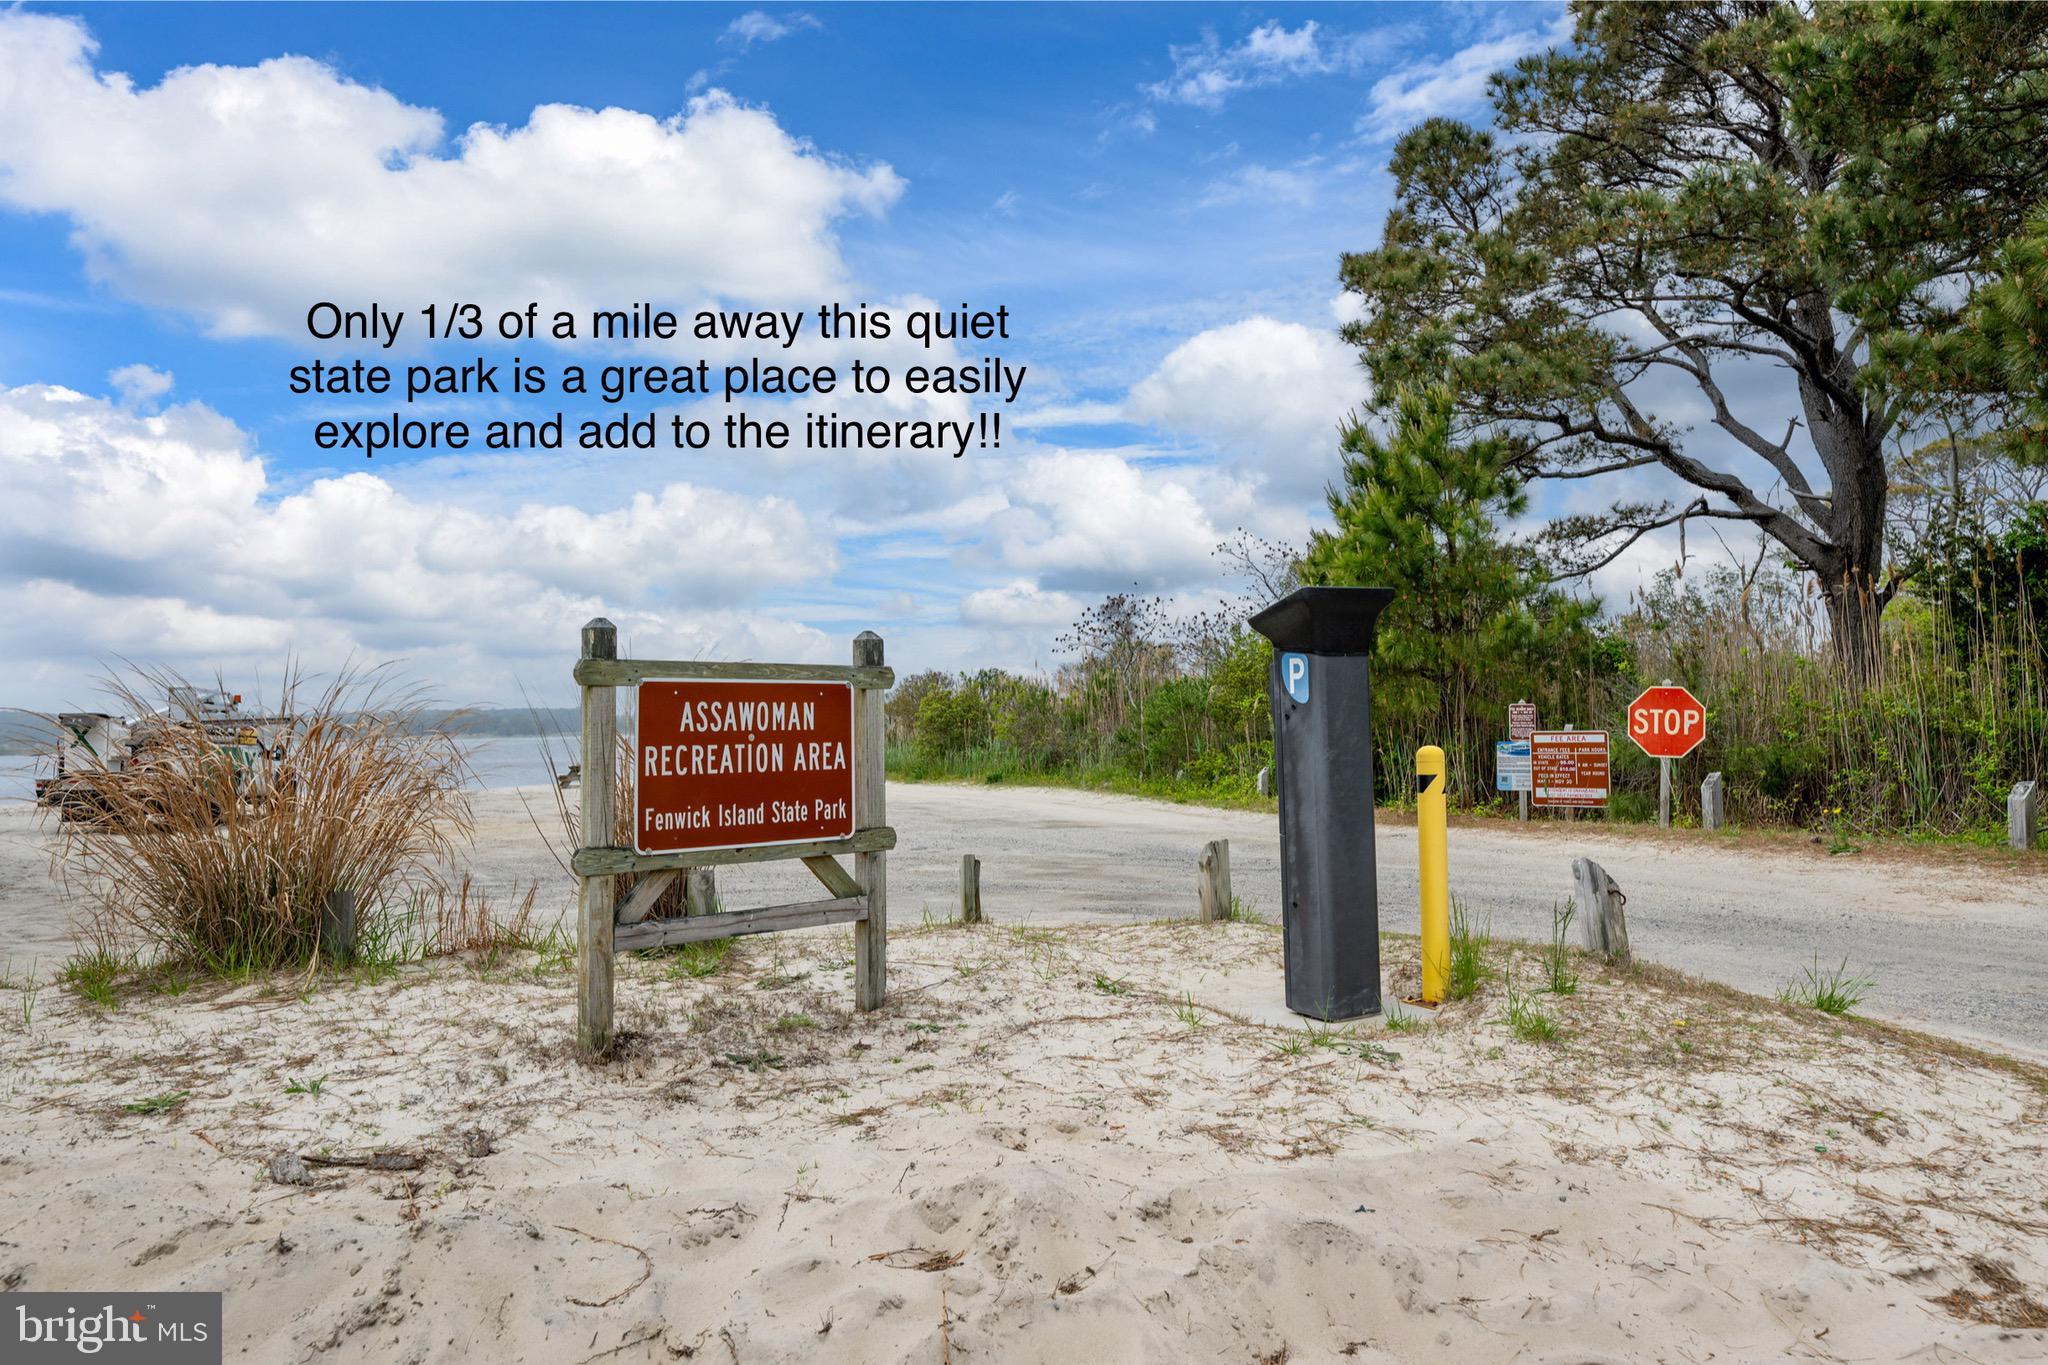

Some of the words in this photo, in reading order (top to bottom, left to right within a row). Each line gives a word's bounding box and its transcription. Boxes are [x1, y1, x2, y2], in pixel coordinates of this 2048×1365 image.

[1289, 658, 1304, 694] P
[680, 701, 815, 732] ASSAWOMAN
[1633, 708, 1700, 735] STOP
[645, 743, 783, 777] RECREATION
[794, 741, 847, 771] AREA
[645, 806, 710, 832] Fenwick
[719, 801, 764, 827] Island
[772, 800, 808, 823] State
[815, 797, 847, 821] Park
